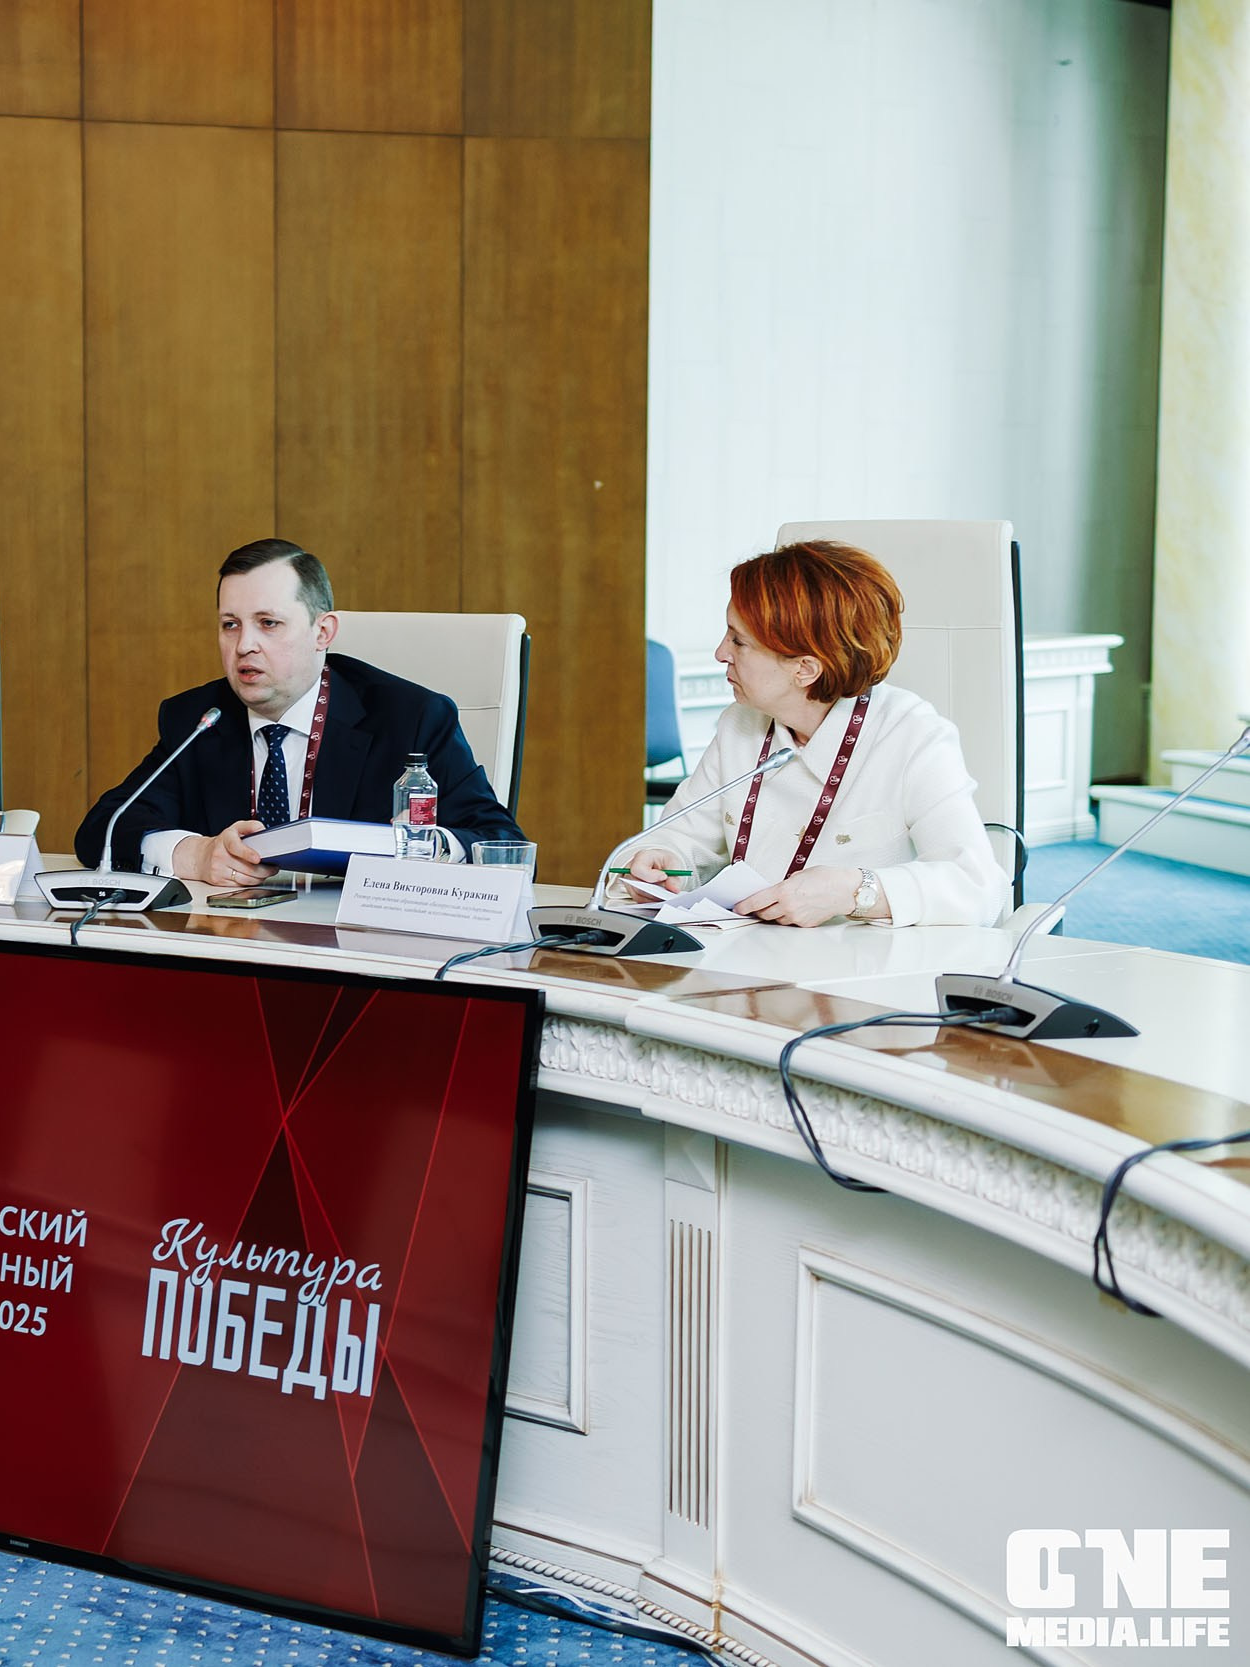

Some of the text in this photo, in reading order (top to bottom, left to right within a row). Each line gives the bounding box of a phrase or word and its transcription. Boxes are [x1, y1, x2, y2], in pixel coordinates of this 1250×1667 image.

[363, 877, 499, 901] Елена Викторовна Куракина
[576, 916, 602, 926] BOSCH
[985, 989, 1014, 1002] BOSCH
[152, 1218, 383, 1304] Культура
[142, 1268, 381, 1400] ПОБЕДЫ
